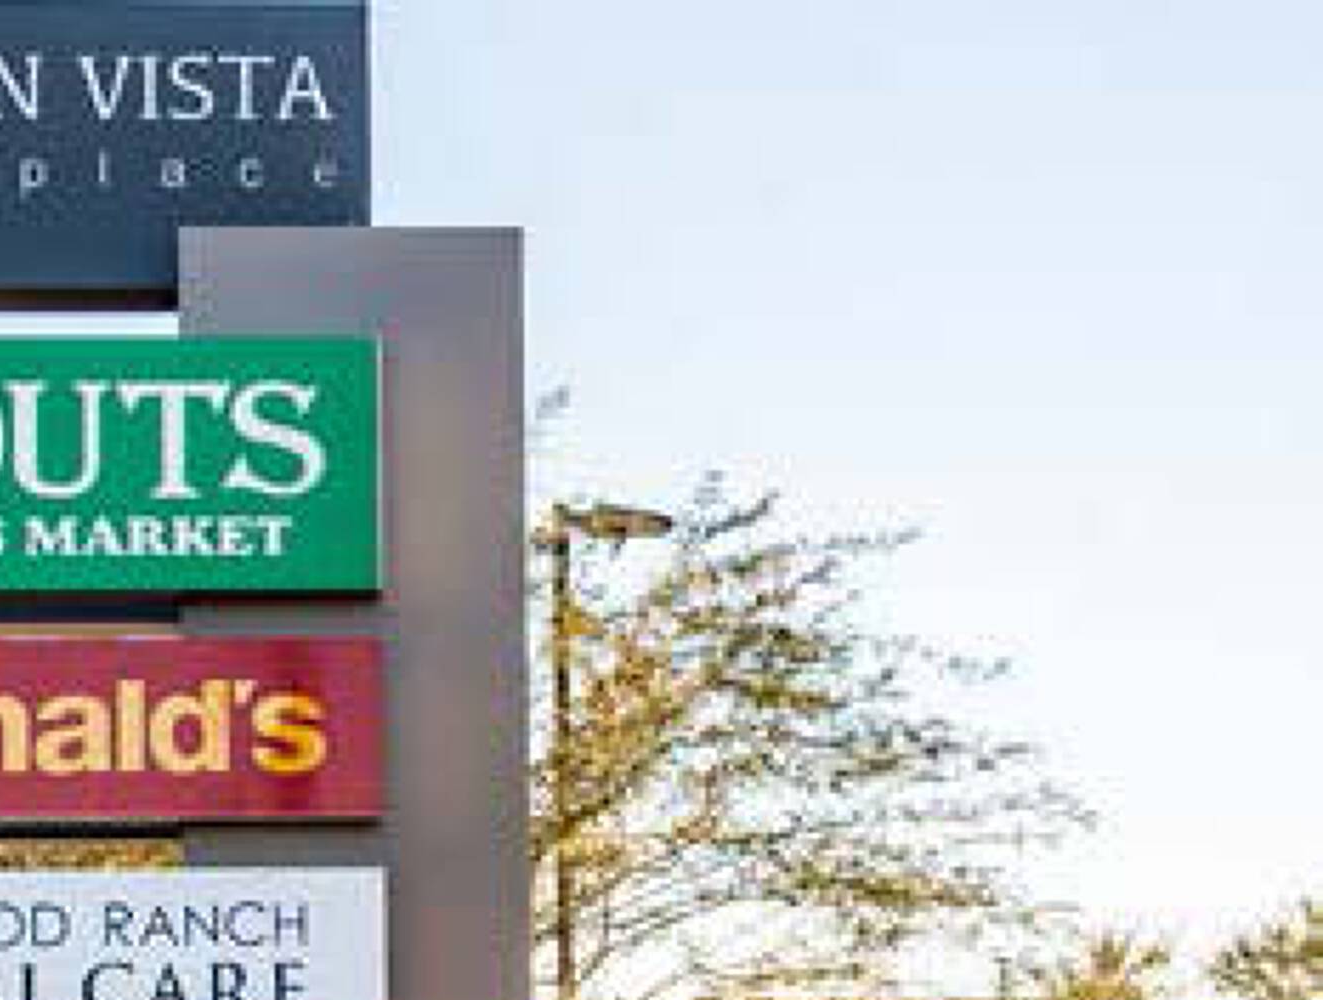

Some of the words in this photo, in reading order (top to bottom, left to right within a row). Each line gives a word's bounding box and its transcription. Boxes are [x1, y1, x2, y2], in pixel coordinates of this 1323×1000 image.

[79, 54, 334, 121] VISTA
[24, 514, 293, 558] MARKET
[103, 902, 309, 948] RANCH
